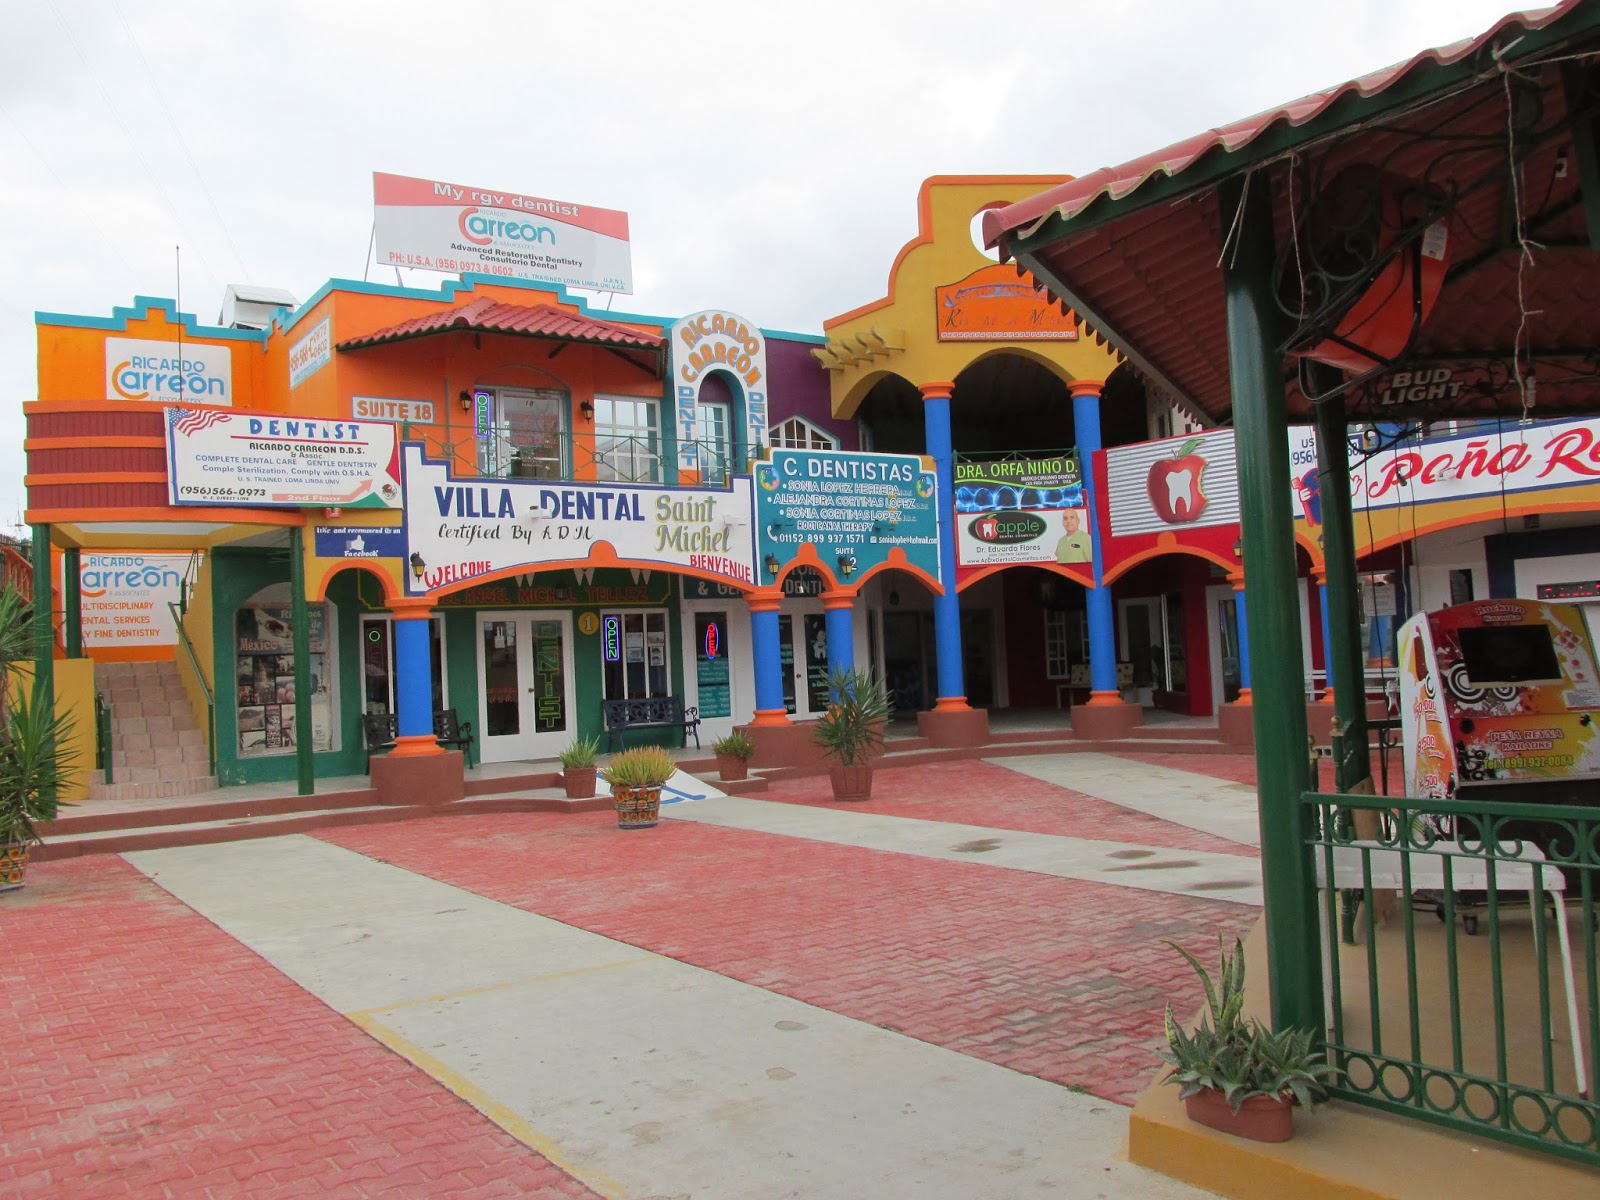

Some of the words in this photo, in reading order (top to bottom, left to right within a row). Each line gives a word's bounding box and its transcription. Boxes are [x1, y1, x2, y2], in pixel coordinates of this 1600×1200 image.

[434, 182, 464, 200] My
[471, 191, 504, 206] rgv
[511, 196, 580, 217] dentist
[450, 242, 493, 255] Advanced
[495, 248, 543, 262] Restorative
[546, 252, 583, 268] Dentistry
[479, 253, 528, 266] Consultorio
[530, 260, 558, 271] Dental
[389, 251, 405, 263] PH:
[407, 253, 434, 267] U.S.A.
[435, 256, 458, 270] (956)
[460, 260, 482, 273] 0973
[484, 264, 491, 275] &
[492, 264, 514, 277] 0602
[680, 313, 760, 356] RICARDO
[132, 356, 206, 373] RICARDO
[681, 342, 762, 388] CARREON
[1391, 368, 1452, 388] BUD
[1381, 382, 1464, 405] LIGHT
[357, 400, 409, 419] SUITE
[413, 404, 432, 421] 18
[477, 394, 488, 435] OPEN
[249, 418, 360, 440] DENTIST
[677, 385, 697, 467] DENTIST
[249, 442, 291, 452] RICARDO
[294, 444, 337, 454] CARREON
[339, 445, 366, 455] D.D.S.
[1301, 437, 1315, 448] US
[195, 454, 240, 464] COMPLETE
[242, 456, 274, 465] DENTAL
[276, 457, 297, 465] CARE
[298, 451, 326, 460] Assoc.
[202, 464, 235, 474] Comple
[236, 466, 288, 476] Sterilization,
[291, 468, 320, 477] Comply
[341, 469, 373, 477] O.S.H.A.
[306, 460, 337, 468] GENTLE
[337, 460, 378, 469] DENTISTRY
[783, 457, 803, 477] C.
[807, 458, 913, 482] DENTISTAS
[956, 464, 987, 479] DRA.
[990, 463, 1025, 477] ORFA
[1065, 460, 1079, 474] D.
[1368, 440, 1533, 499] Peña
[180, 486, 266, 497] (956)566-0973
[787, 480, 819, 492] SONIA
[821, 482, 853, 494] LOPEZ
[854, 484, 900, 496] HERRERA
[434, 486, 516, 519] VILLA
[539, 489, 646, 521] DENTAL
[655, 494, 718, 523] Saint
[773, 493, 835, 506] ALEJANDRA
[836, 495, 885, 507] CORTINAS
[885, 497, 917, 510] LOPEZ
[786, 508, 819, 519] SONIA
[820, 509, 870, 521] CORTINAS
[870, 510, 902, 522] LOPEZ
[438, 523, 501, 547] Certified
[511, 525, 532, 545] By
[558, 525, 570, 540] D
[797, 521, 817, 531] ROOT
[817, 522, 841, 532] CANAL
[841, 522, 875, 533] THERAPY
[996, 519, 1040, 536] apple
[655, 524, 732, 553] Michel
[780, 534, 804, 543] 01152
[807, 534, 824, 543] 899
[827, 534, 843, 543] 937
[846, 534, 865, 543] 1571
[835, 547, 854, 555] SUITE
[976, 545, 986, 553] Dr.
[987, 545, 1019, 553] Eduardo
[90, 556, 145, 567] RICARDO
[689, 554, 752, 582] BIENVENUE
[849, 557, 858, 570] 2
[425, 560, 492, 588] WELCOME
[697, 580, 709, 596] &
[81, 616, 111, 625] ENTAL
[113, 615, 151, 625] SERVICES
[584, 617, 593, 631] 1
[94, 630, 114, 638] FINE
[116, 628, 160, 638] DENTISTRY
[607, 619, 617, 659] OPEN
[707, 623, 716, 656] OPEN
[1523, 729, 1564, 740] REYNA
[1502, 741, 1553, 751] KARAOKE
[1501, 757, 1527, 769] (899)
